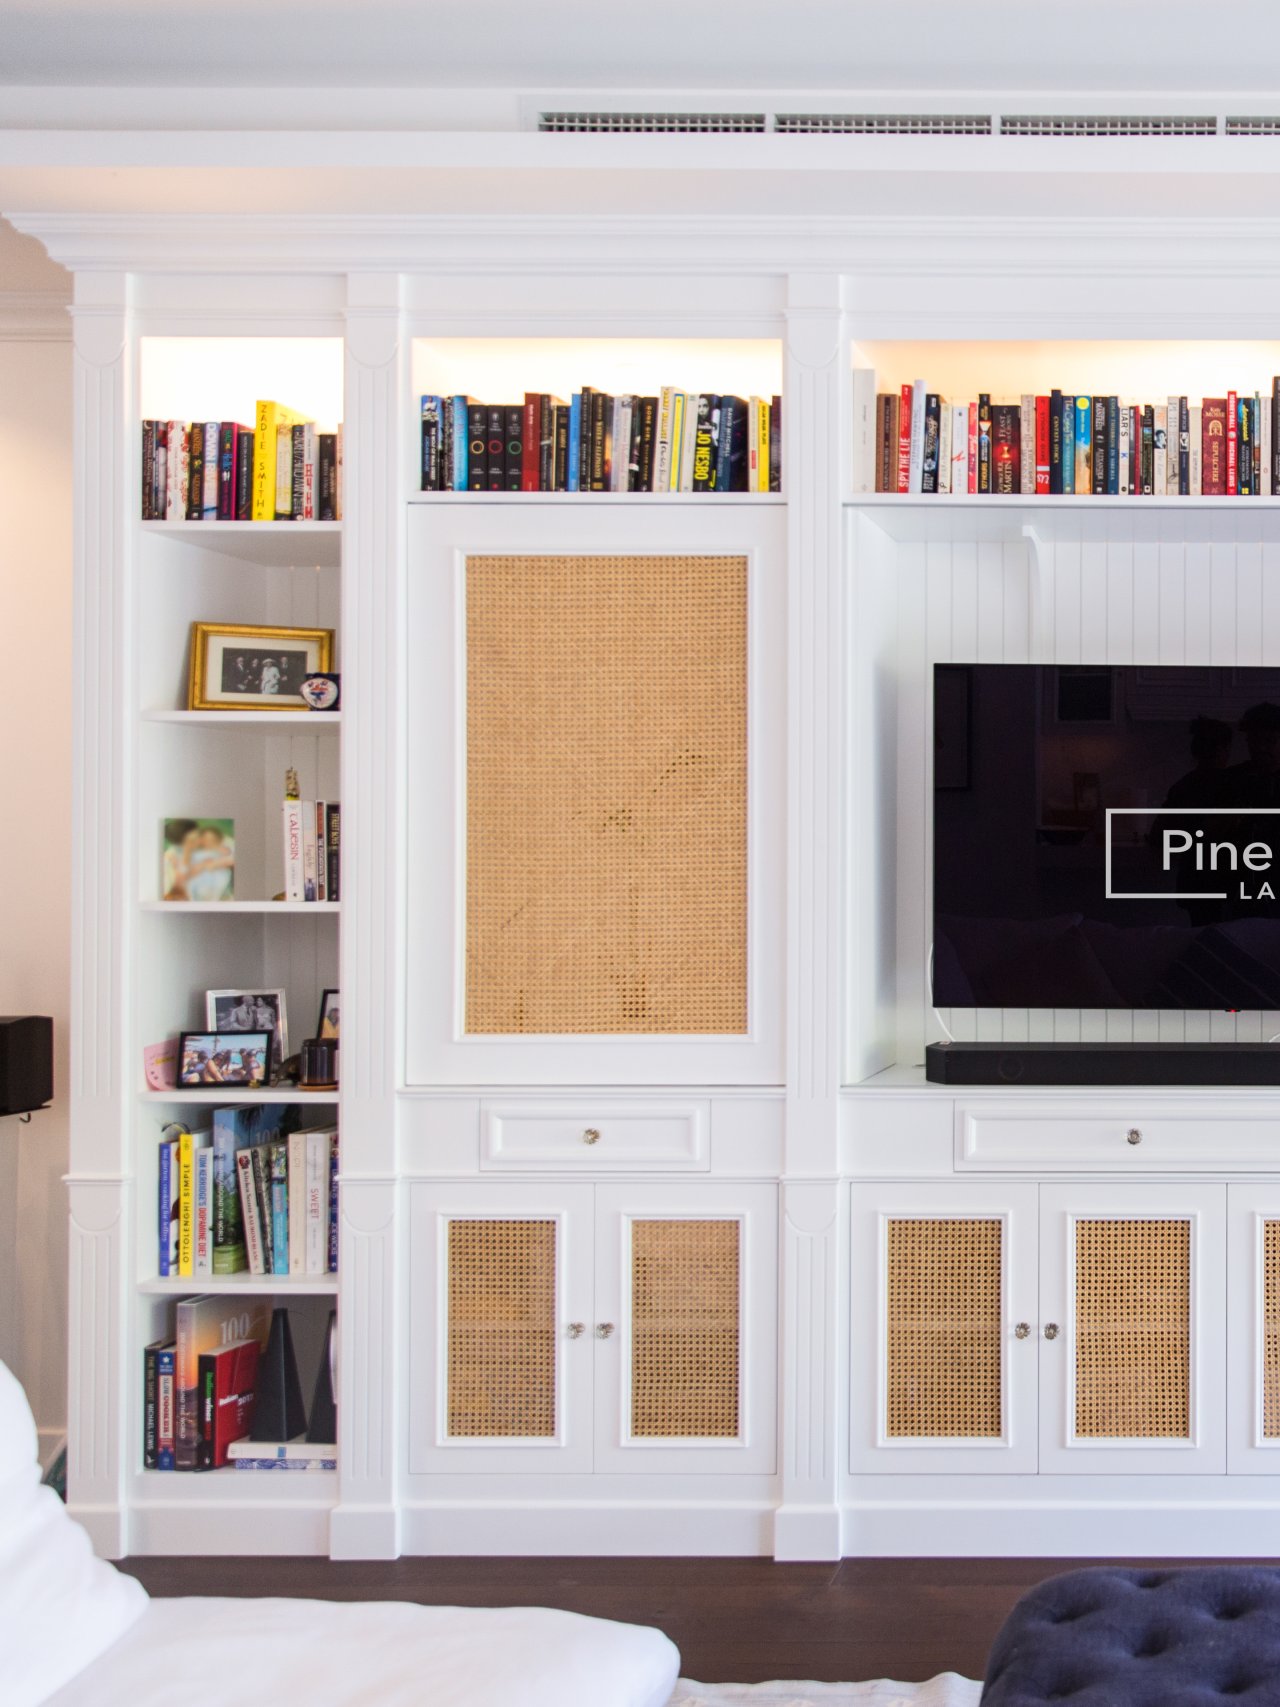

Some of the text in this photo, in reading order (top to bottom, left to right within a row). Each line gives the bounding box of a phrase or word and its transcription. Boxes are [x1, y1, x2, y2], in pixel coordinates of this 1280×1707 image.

[206, 423, 218, 461] DOWN
[698, 430, 711, 444] JO
[899, 438, 910, 488] SPY THE LIE
[1162, 829, 1273, 871] Pine
[198, 1154, 207, 1168] TOM
[311, 1188, 320, 1219] SWEET
[198, 1207, 207, 1240] DOPAMINE
[198, 1242, 207, 1257] DIET
[221, 1312, 250, 1345] 100
